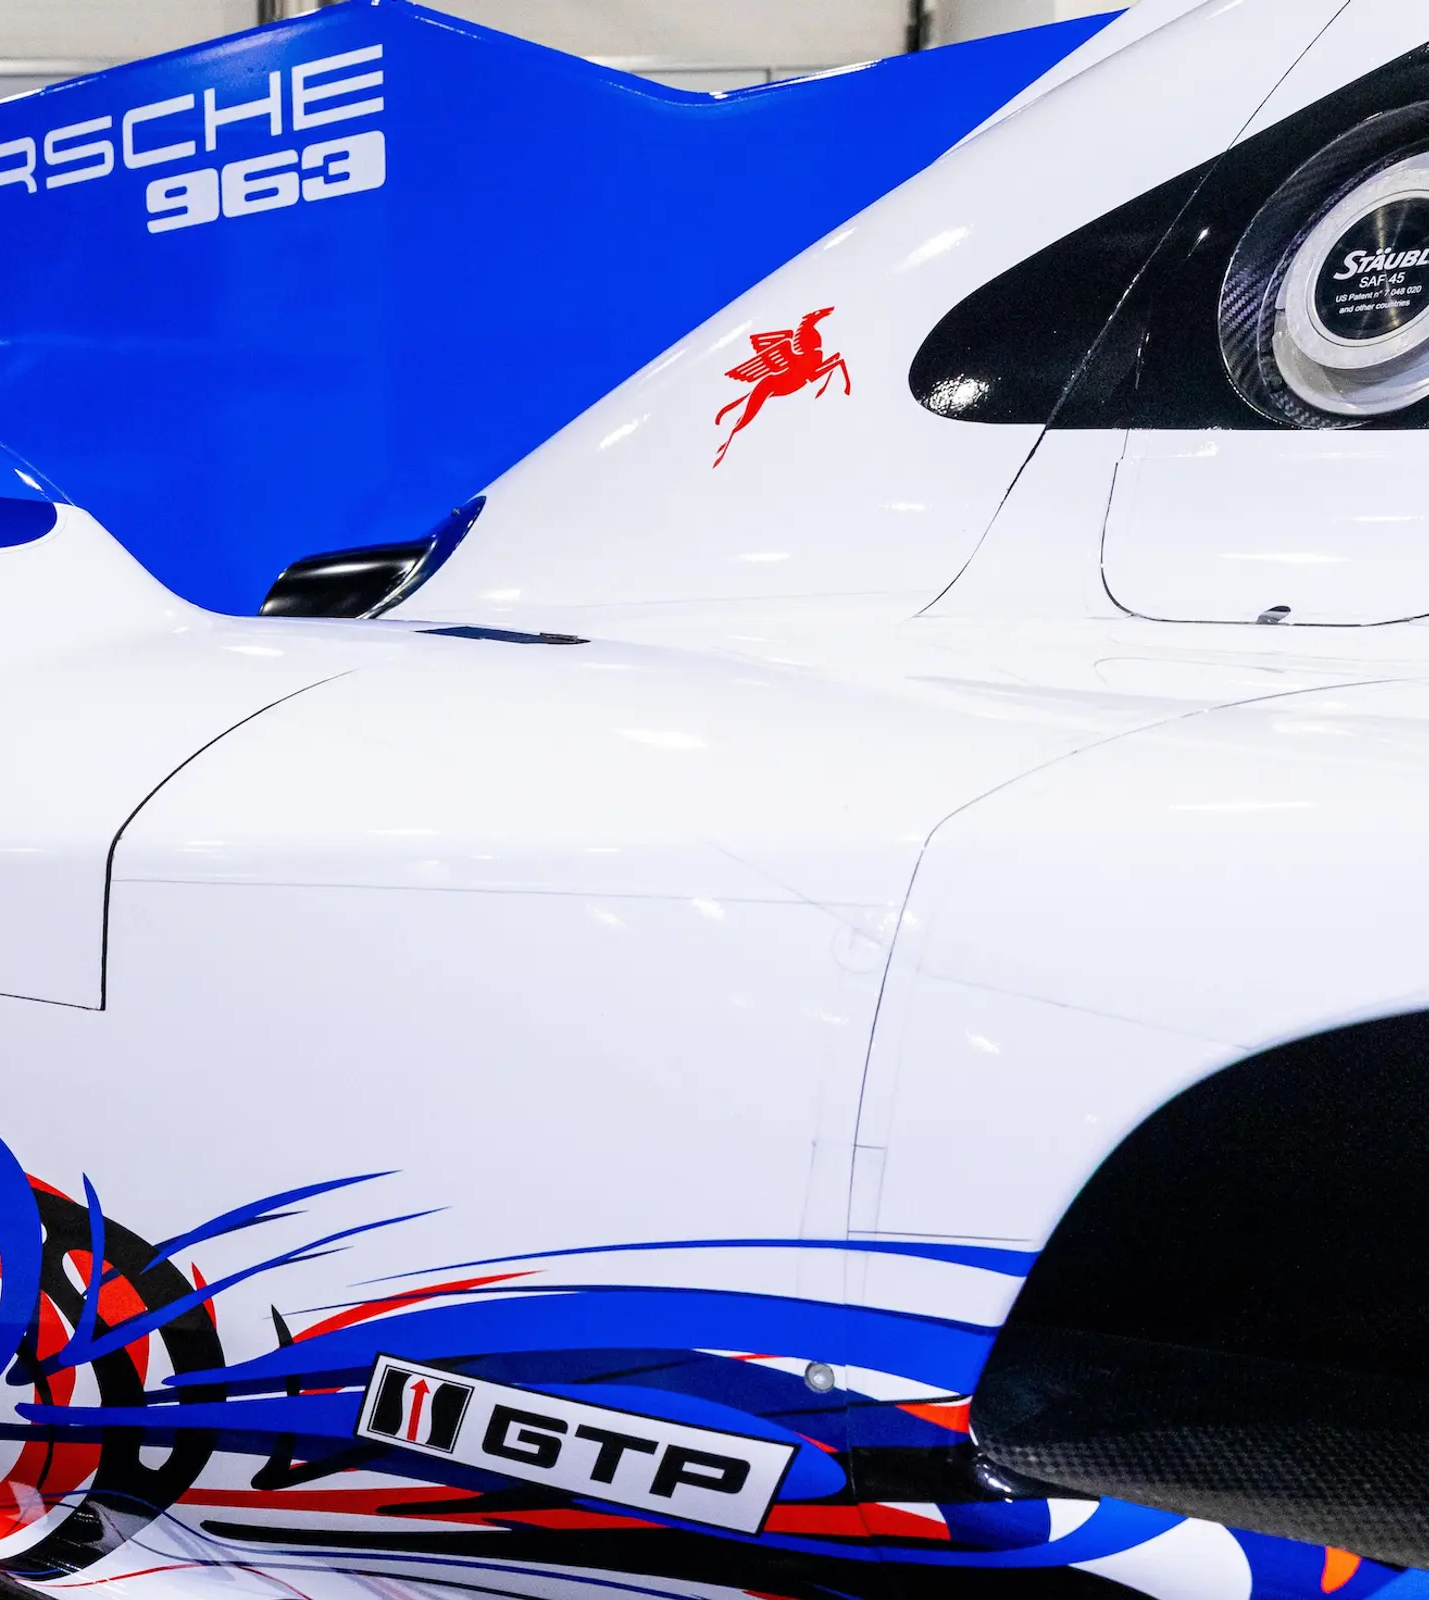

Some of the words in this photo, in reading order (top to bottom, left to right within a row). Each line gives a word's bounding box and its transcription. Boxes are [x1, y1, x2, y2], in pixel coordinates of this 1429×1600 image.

[145, 130, 386, 234] 963
[1358, 274, 1387, 288] SAF
[1388, 271, 1406, 285] 45
[1335, 294, 1348, 303] US
[1348, 291, 1373, 301] Patent
[1384, 289, 1390, 297] 7
[1390, 287, 1406, 296] 048
[1406, 285, 1423, 294] 020
[1338, 305, 1354, 314] and
[1354, 303, 1375, 312] other
[1375, 300, 1411, 310] countries
[481, 1403, 751, 1499] GTP
